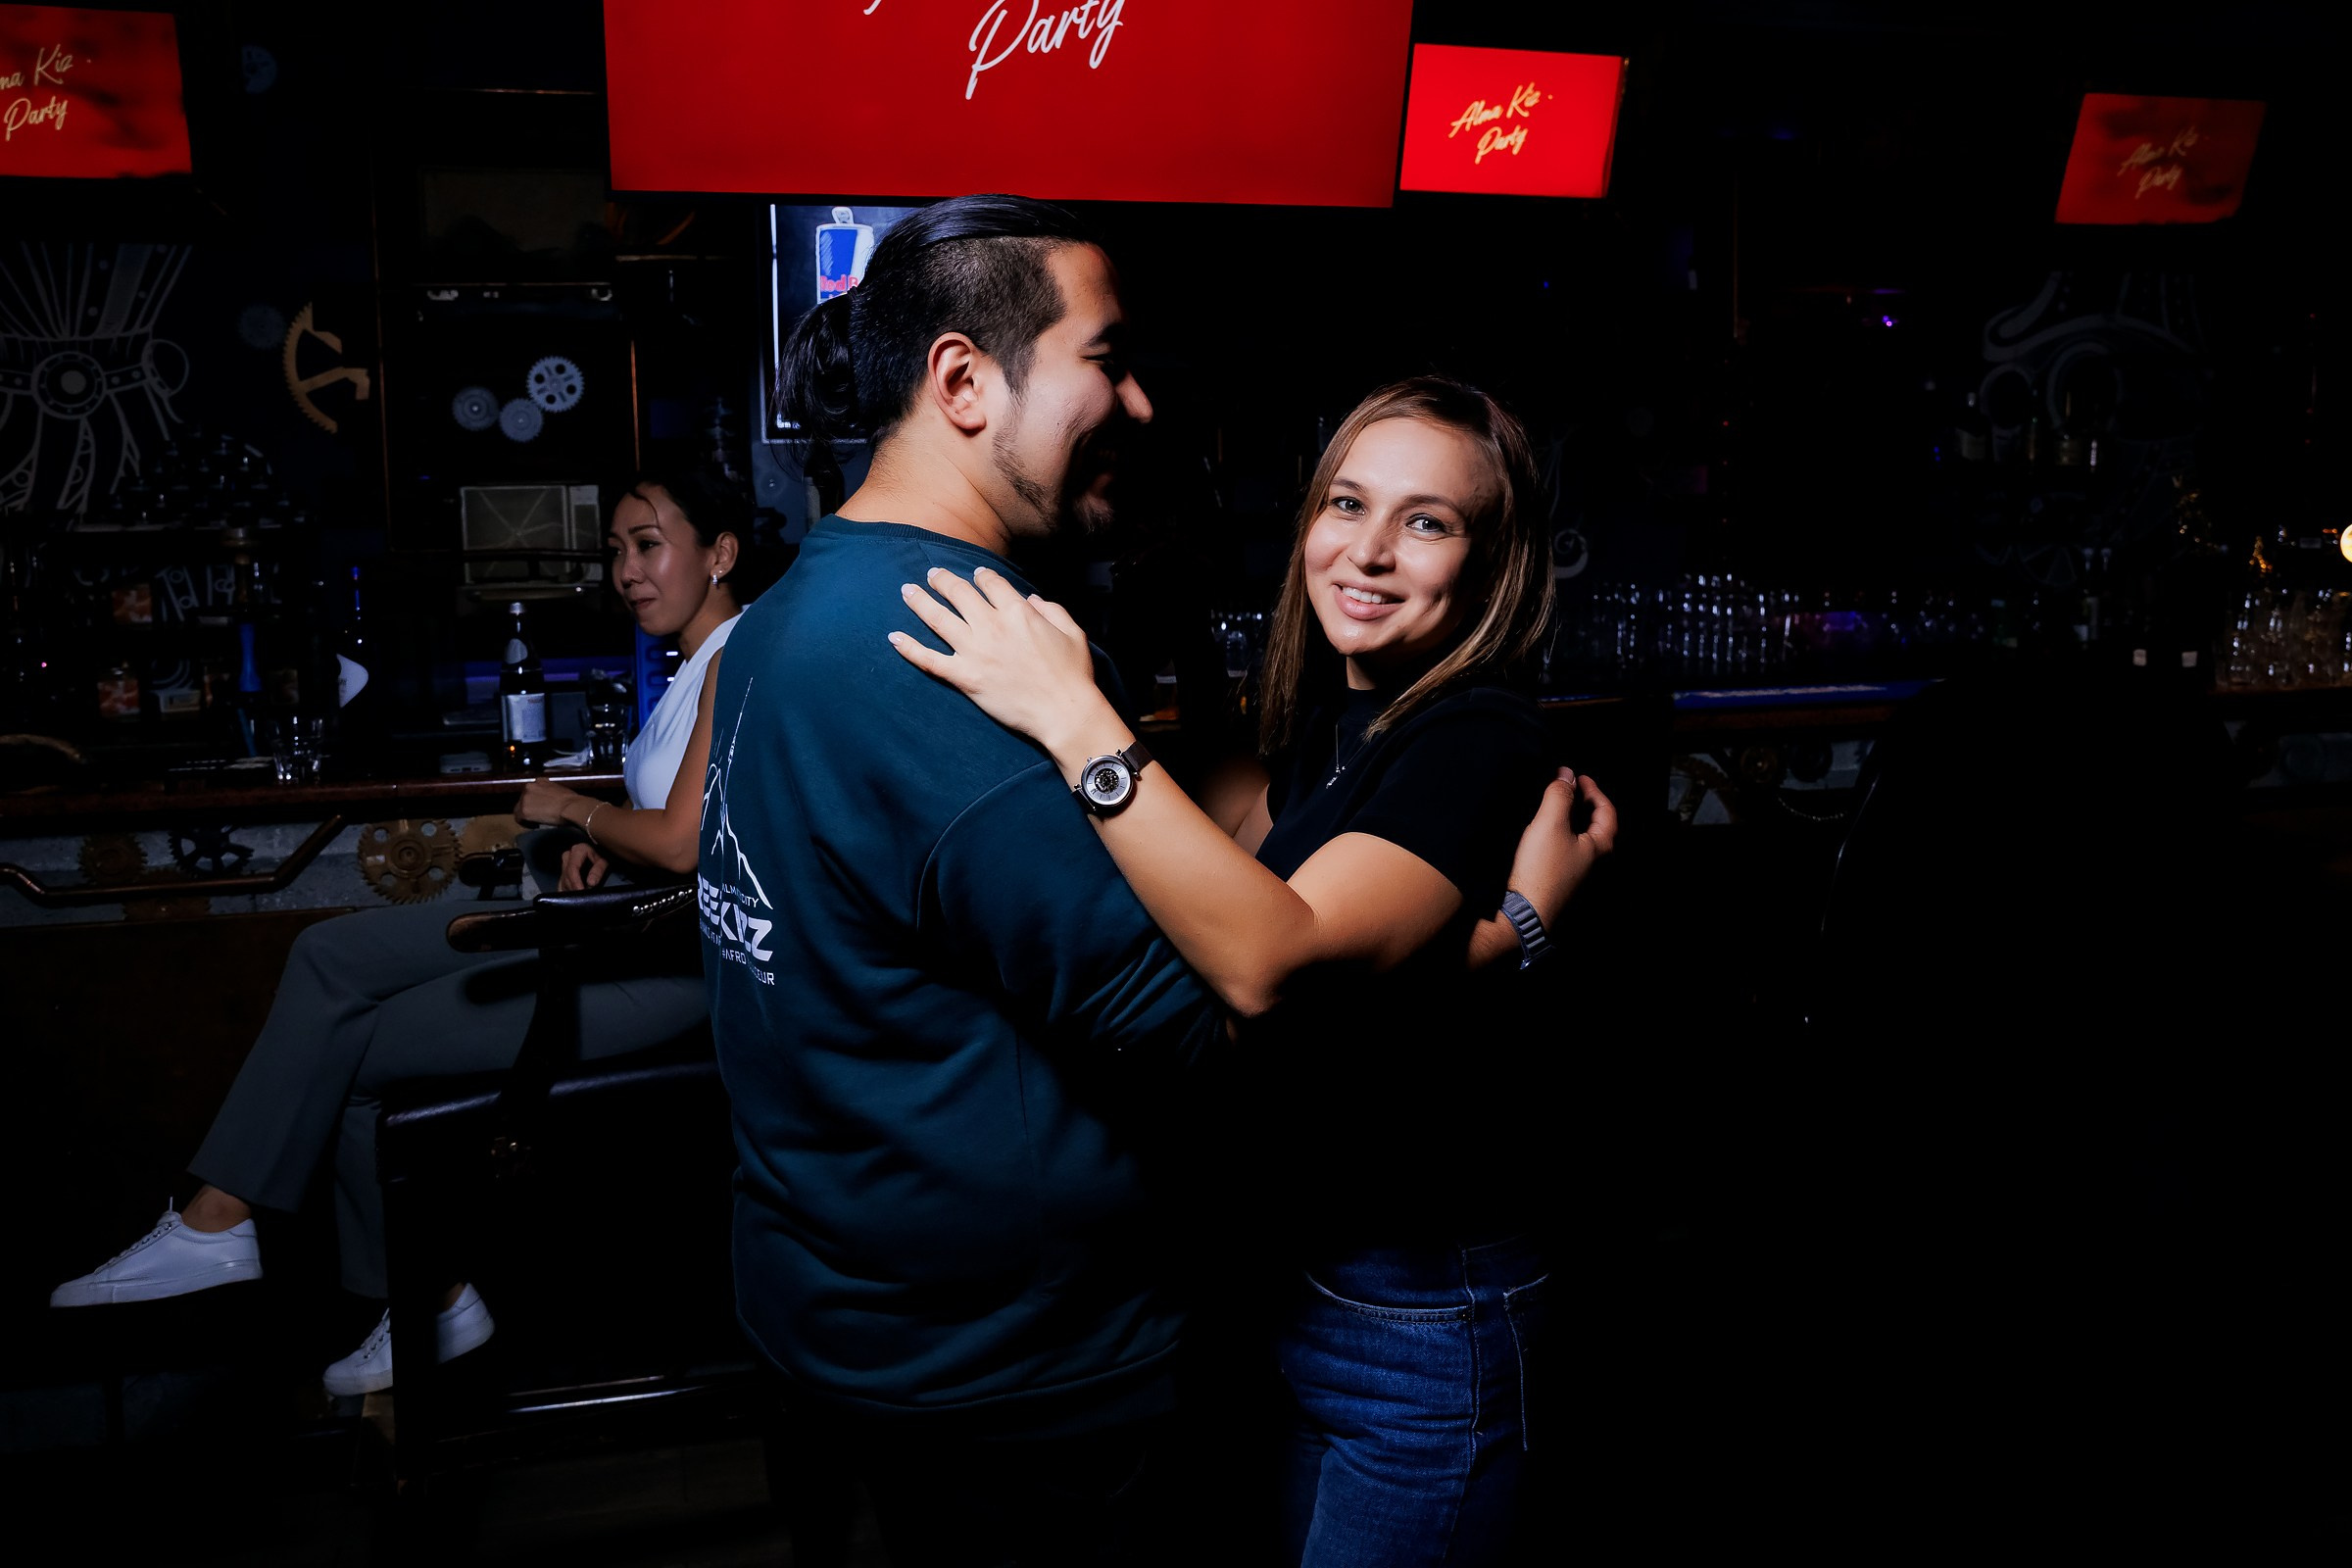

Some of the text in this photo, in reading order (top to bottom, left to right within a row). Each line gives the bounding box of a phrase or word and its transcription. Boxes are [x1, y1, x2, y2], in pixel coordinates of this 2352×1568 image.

[965, 0, 1124, 100] Party
[3, 95, 69, 141] Party
[1474, 124, 1529, 165] Party
